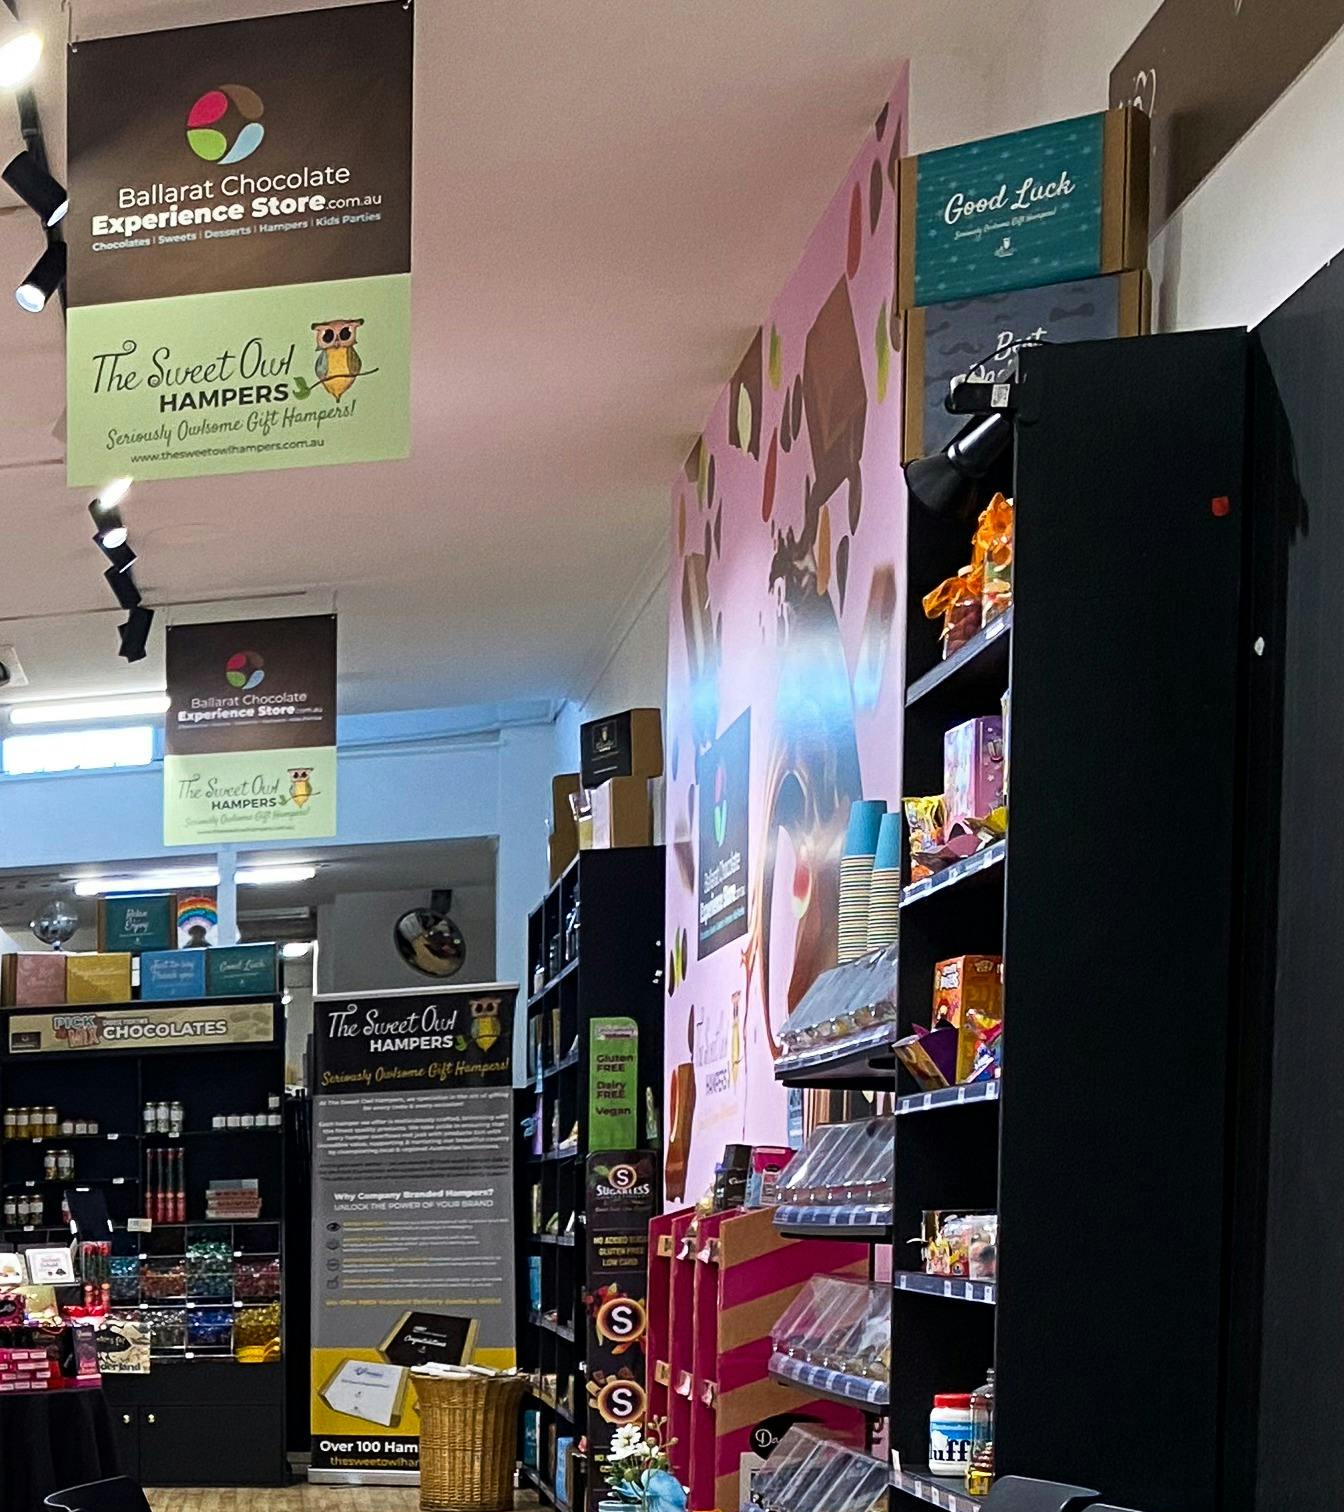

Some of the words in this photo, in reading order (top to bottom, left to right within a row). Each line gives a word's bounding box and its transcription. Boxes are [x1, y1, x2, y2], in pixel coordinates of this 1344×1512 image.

[118, 178, 215, 210] Ballarat
[220, 165, 352, 197] Chocolate
[943, 183, 1009, 226] Good
[1009, 170, 1077, 212] Luck
[91, 202, 246, 239] Experience
[92, 236, 151, 253] Chocolates
[158, 231, 198, 246] Sweets
[204, 226, 252, 241] Desserts
[258, 219, 309, 236] Hampers
[315, 214, 341, 228] Kids
[342, 210, 382, 225] Parties
[92, 338, 143, 396] The
[146, 344, 235, 389] Sweet
[239, 336, 296, 379] Owl
[159, 383, 290, 415] HAMPERS
[105, 424, 173, 452] Seriously
[176, 415, 243, 441] Owlsome
[245, 405, 280, 437] Gift
[281, 399, 357, 432] Hampers!
[129, 436, 326, 465] www.thesweetowlhampers.com.au
[190, 696, 240, 711] Ballarat
[242, 691, 308, 708] Chocolate
[177, 706, 255, 724] Experience
[178, 772, 205, 800] The
[205, 776, 251, 799] Sweet
[251, 774, 281, 795] Owl
[211, 797, 278, 812] HAMPERS
[52, 1013, 99, 1032] PICK
[102, 1020, 229, 1041] CHOCOLATES
[327, 1003, 362, 1039] The
[362, 1007, 421, 1037] Sweet
[421, 1004, 459, 1032] Owl
[369, 1034, 455, 1054] HAMPERS
[596, 1054, 634, 1064] Gluten
[597, 1063, 626, 1073] FREE
[320, 1070, 373, 1088] Seriously
[374, 1066, 427, 1083] Owlsome
[427, 1061, 453, 1082] Gift
[454, 1056, 511, 1078] Hampers!
[596, 1081, 626, 1091] Dairy
[597, 1090, 626, 1100] FREE
[595, 1106, 632, 1117] Vegan
[333, 1192, 357, 1202] Why
[357, 1191, 403, 1202] Company
[403, 1189, 445, 1200] Branded
[445, 1187, 495, 1200] Hampers?
[370, 1202, 387, 1211] THE
[388, 1201, 421, 1210] POWER
[422, 1201, 435, 1210] OF
[436, 1200, 460, 1209] YOUR
[461, 1199, 495, 1209] BRAND
[319, 1439, 354, 1453] Over
[355, 1439, 382, 1453] 100
